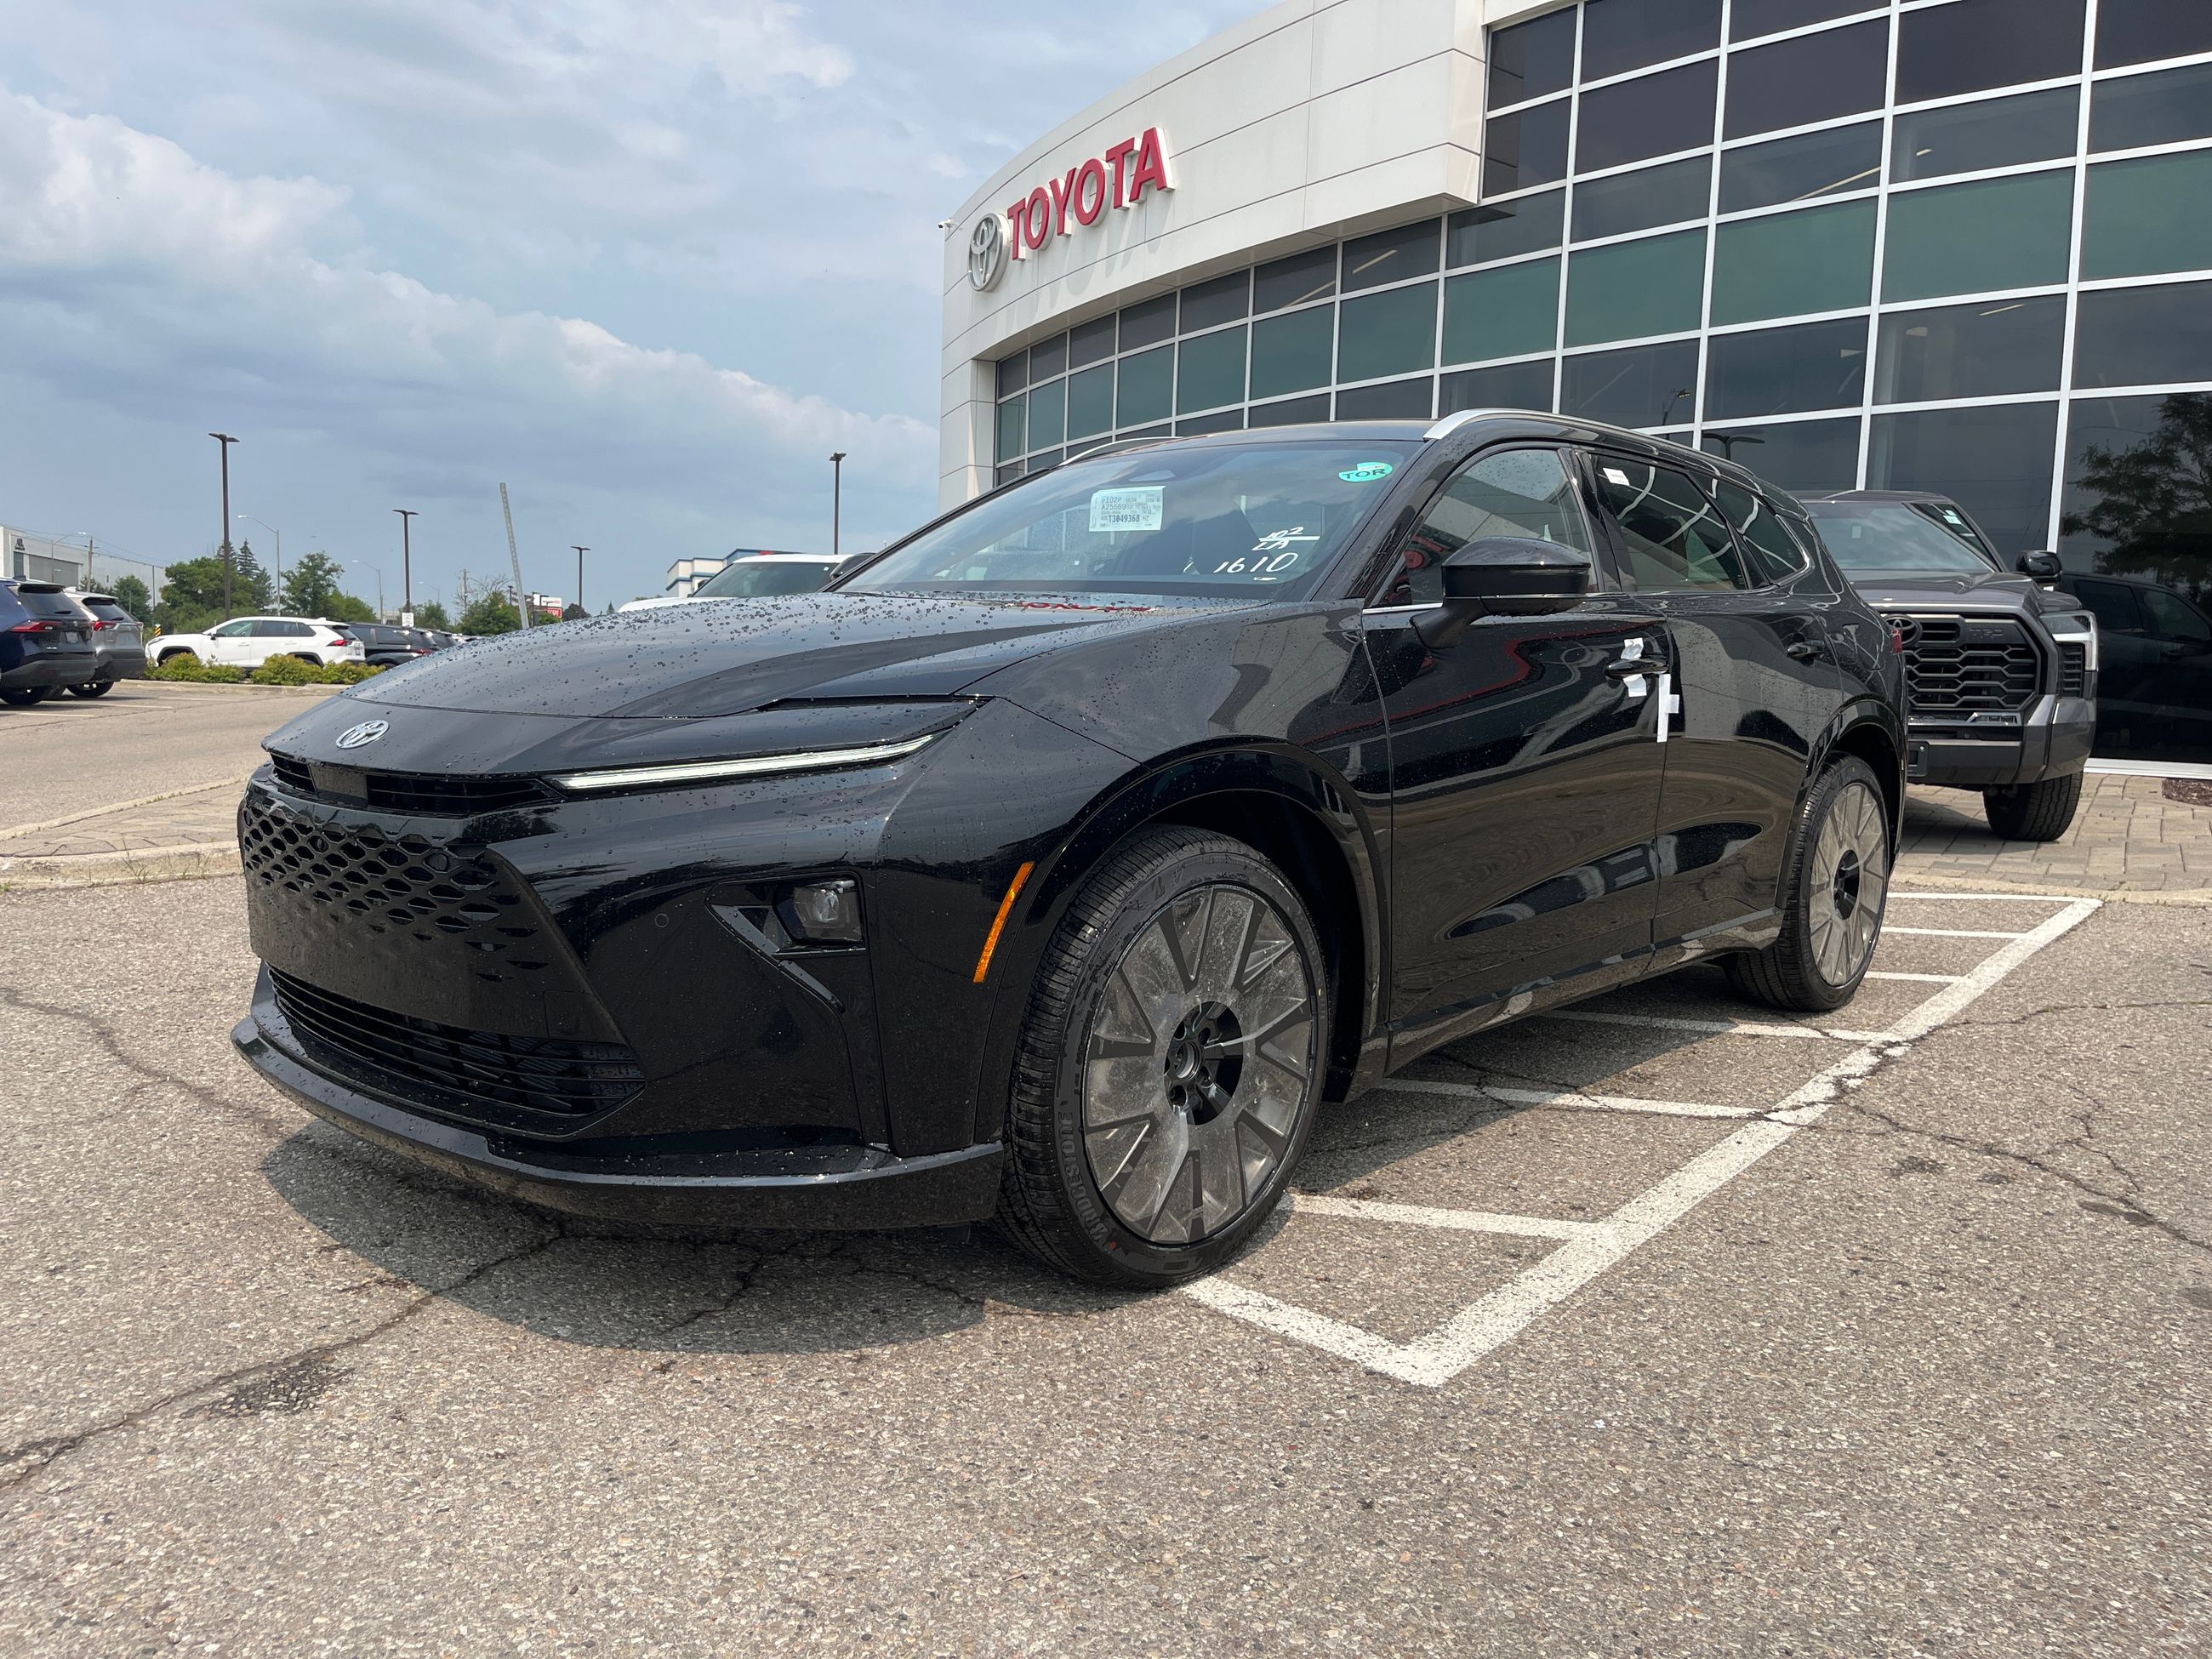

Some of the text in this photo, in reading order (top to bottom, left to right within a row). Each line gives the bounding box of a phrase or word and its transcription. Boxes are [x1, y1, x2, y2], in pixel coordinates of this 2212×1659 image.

[1007, 127, 1172, 261] TOYOTA
[1342, 469, 1386, 479] TOR
[1109, 514, 1140, 522] T3049368
[1213, 552, 1299, 573] 1610
[1058, 1112, 1109, 1241] BRIDGESTONE
